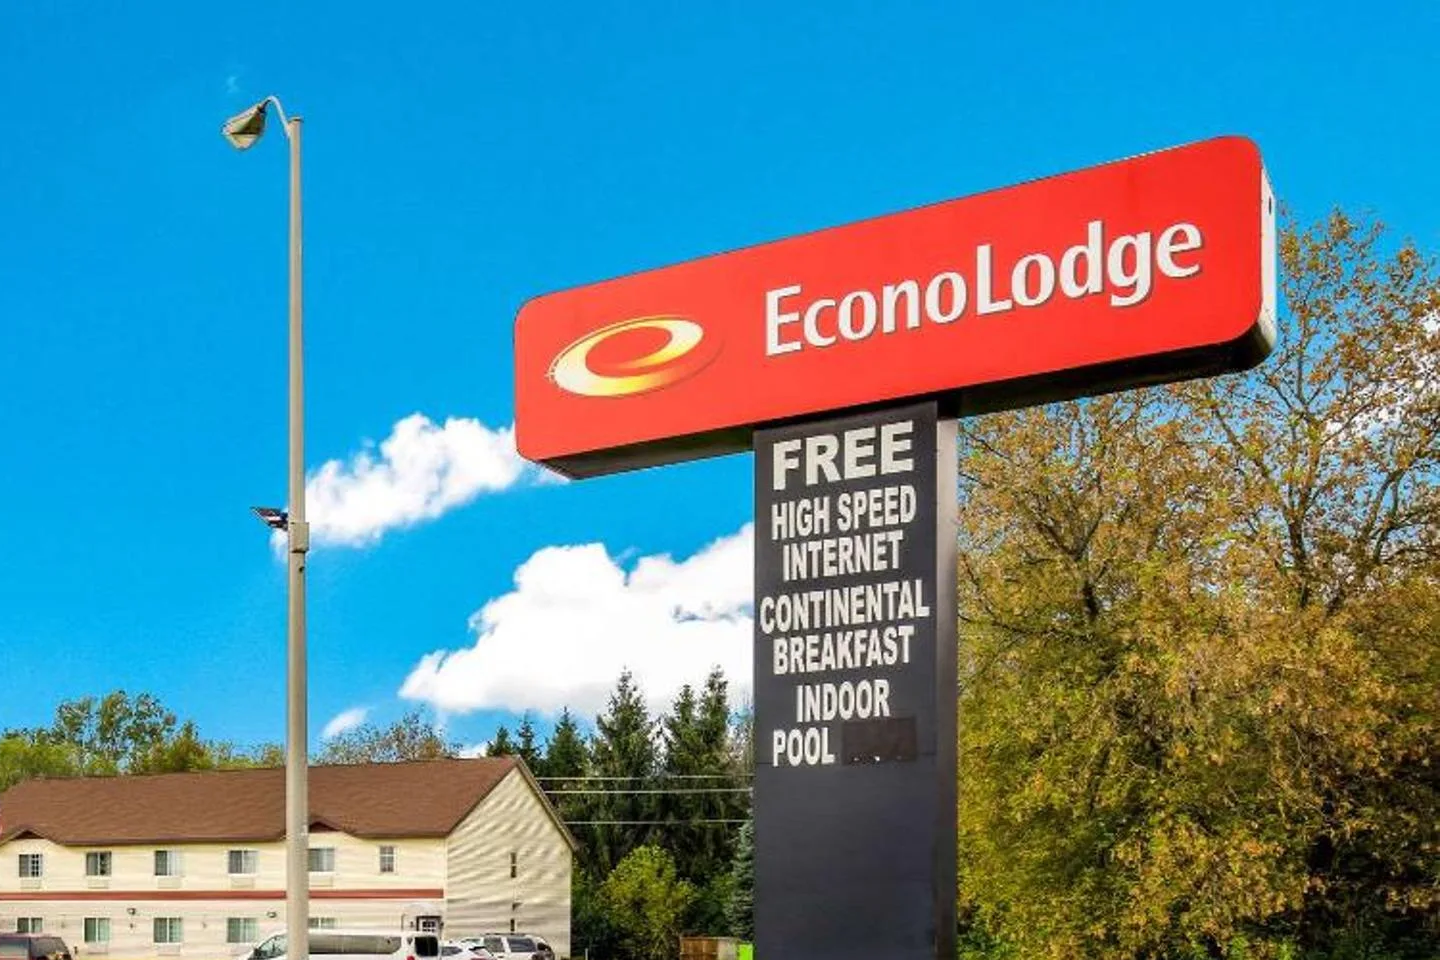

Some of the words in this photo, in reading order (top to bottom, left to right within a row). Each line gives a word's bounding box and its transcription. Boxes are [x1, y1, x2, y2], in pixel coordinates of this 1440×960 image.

[764, 220, 1203, 356] EconoLodge
[772, 420, 915, 490] FREE
[771, 496, 830, 540] HIGH
[837, 485, 917, 532] SPEED
[782, 529, 904, 582] INTERNET
[759, 578, 930, 634] CONTINENTAL
[772, 625, 915, 675] BREAKFAST
[796, 679, 891, 723] INDOOR
[772, 727, 835, 767] POOL
